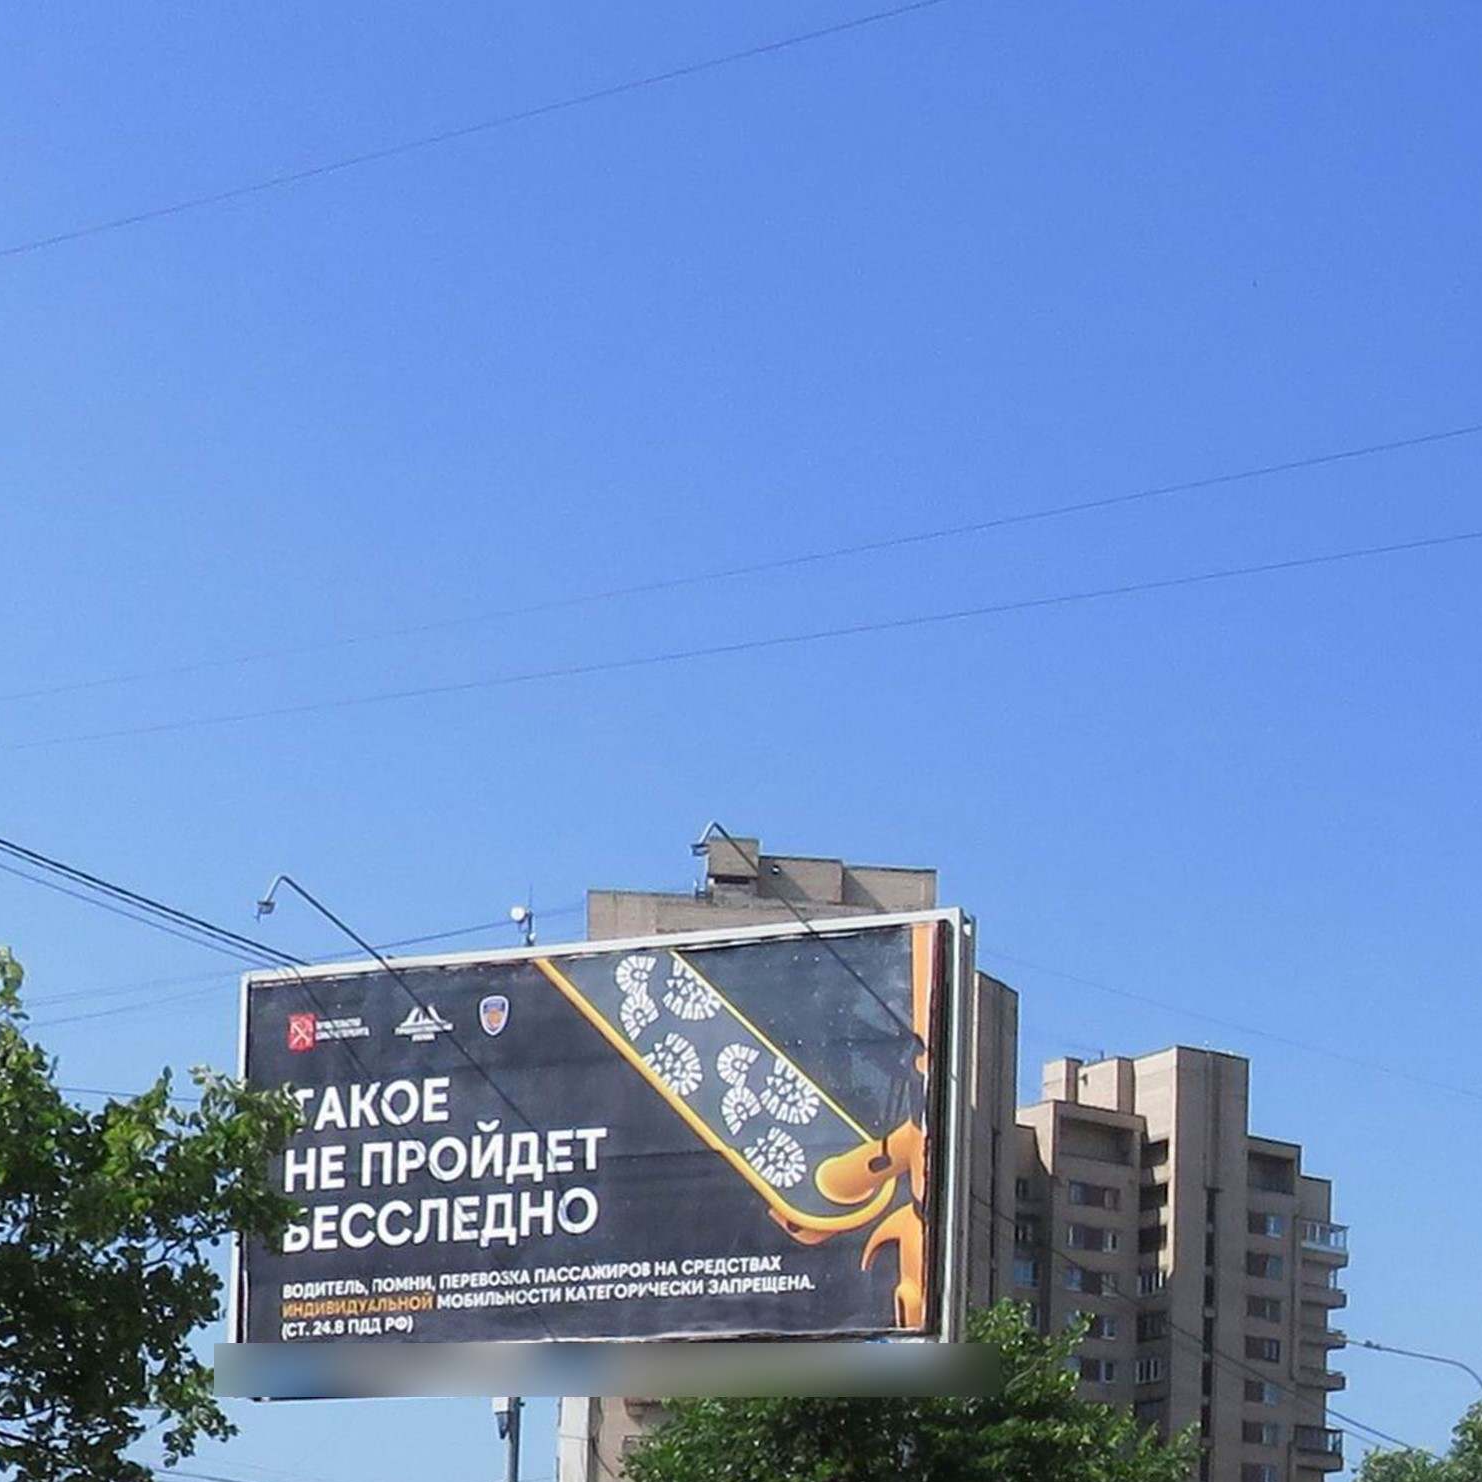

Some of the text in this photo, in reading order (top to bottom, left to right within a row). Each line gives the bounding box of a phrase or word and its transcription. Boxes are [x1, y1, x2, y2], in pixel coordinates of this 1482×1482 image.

[284, 1119, 608, 1192] НЕ ПРОЙДЕТ
[283, 1187, 599, 1253] БЕССЛЕДНО
[282, 1255, 782, 1299] ВОДИТЕЛЬ, ПОМНИ, ПЕРЕВОЗКА ПАССАЖИРОВ НА СРЕДСТВАХ
[282, 1274, 816, 1318] ИНДИВИДУАЛЬНОЙ МОБИЛЬНОСТИ КАТЕГОРИЧЕСКИ ЗАПРЕЩЕНА.
[281, 1321, 310, 1341] (СТ.
[347, 1317, 382, 1336] ПДД
[385, 1315, 415, 1334] РФ)
